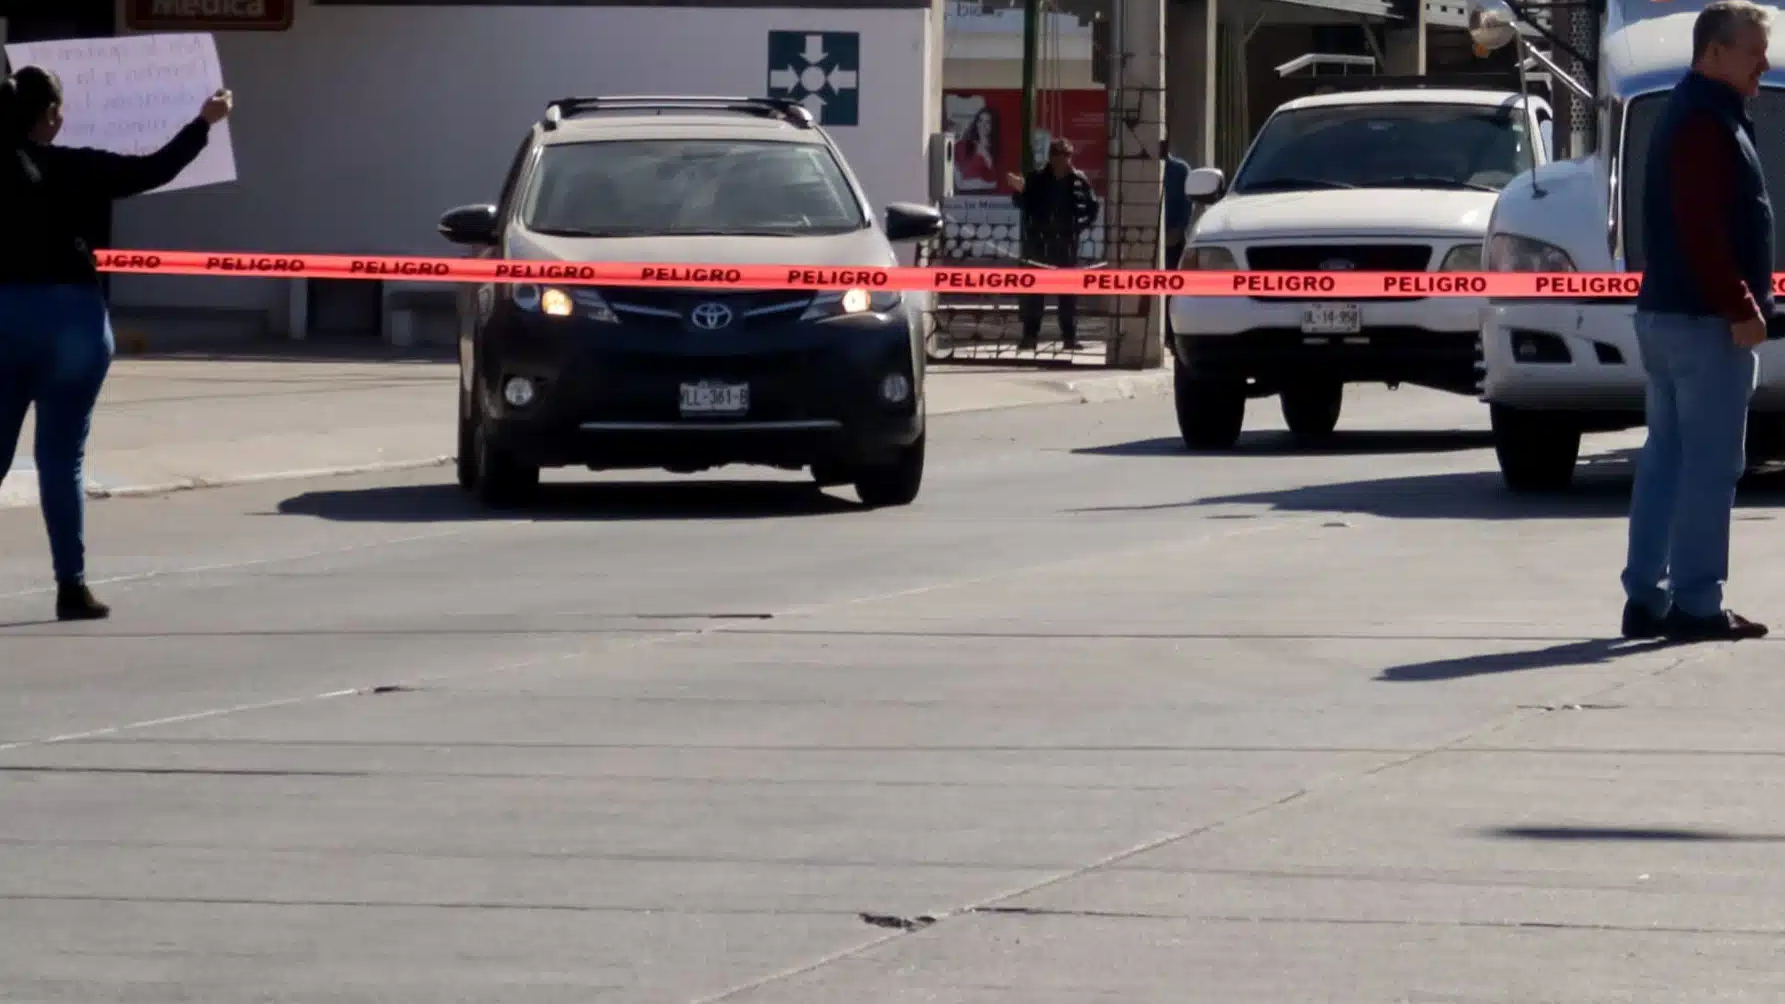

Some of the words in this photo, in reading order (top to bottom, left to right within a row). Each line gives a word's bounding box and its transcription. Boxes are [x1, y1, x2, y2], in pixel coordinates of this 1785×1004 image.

[205, 256, 304, 272] PELIGRO
[350, 260, 450, 277] PELIGRO
[495, 264, 595, 280] PELIGRO
[641, 267, 741, 283] PELIGRO
[787, 270, 889, 286] PELIGRO
[934, 272, 1036, 288] PELIGRO
[1083, 274, 1185, 290] PELIGRO
[1233, 275, 1335, 292] PELIGRO
[1383, 276, 1487, 293] PELIGRO
[1536, 276, 1640, 294] PELIGRO
